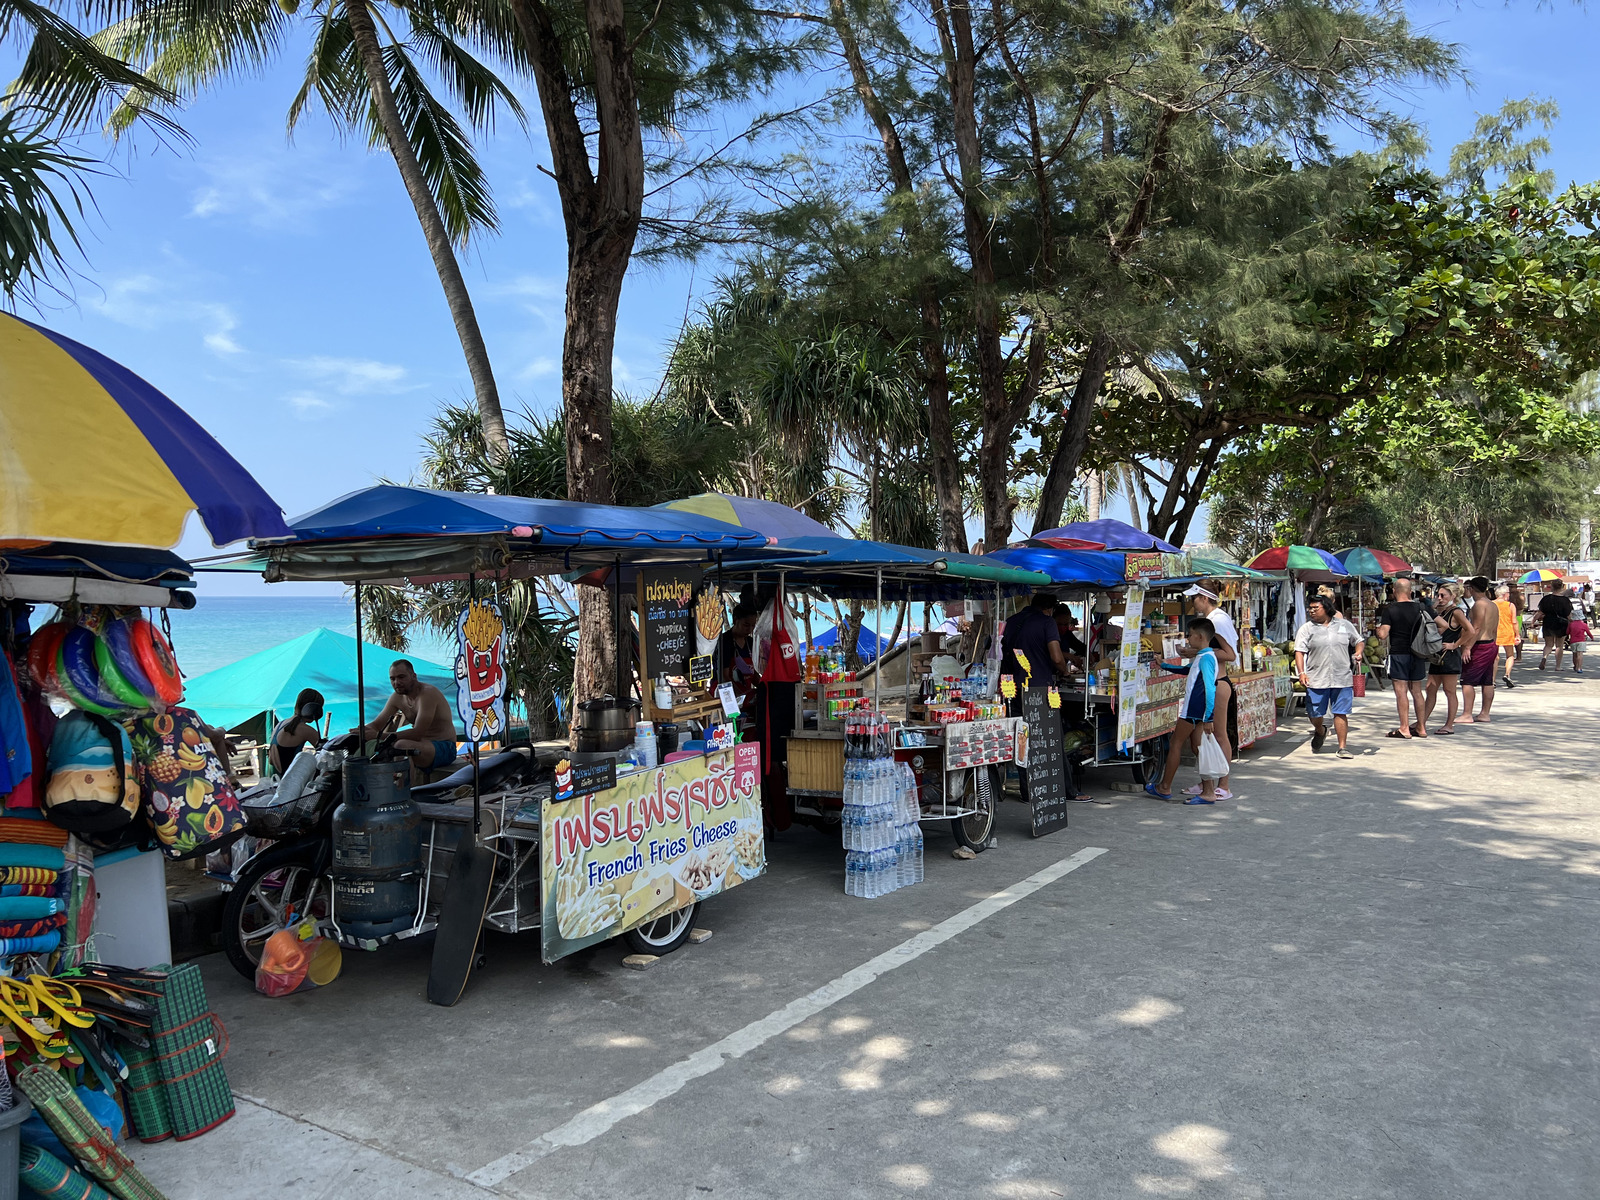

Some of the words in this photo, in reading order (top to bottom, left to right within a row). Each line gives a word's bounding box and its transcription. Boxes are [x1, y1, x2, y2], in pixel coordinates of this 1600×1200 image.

[660, 638, 684, 651] CHEESE
[663, 653, 682, 664] BBQ
[738, 747, 757, 757] OPEN
[588, 846, 643, 887] French
[649, 838, 687, 865] Fries
[692, 820, 738, 850] Cheese
